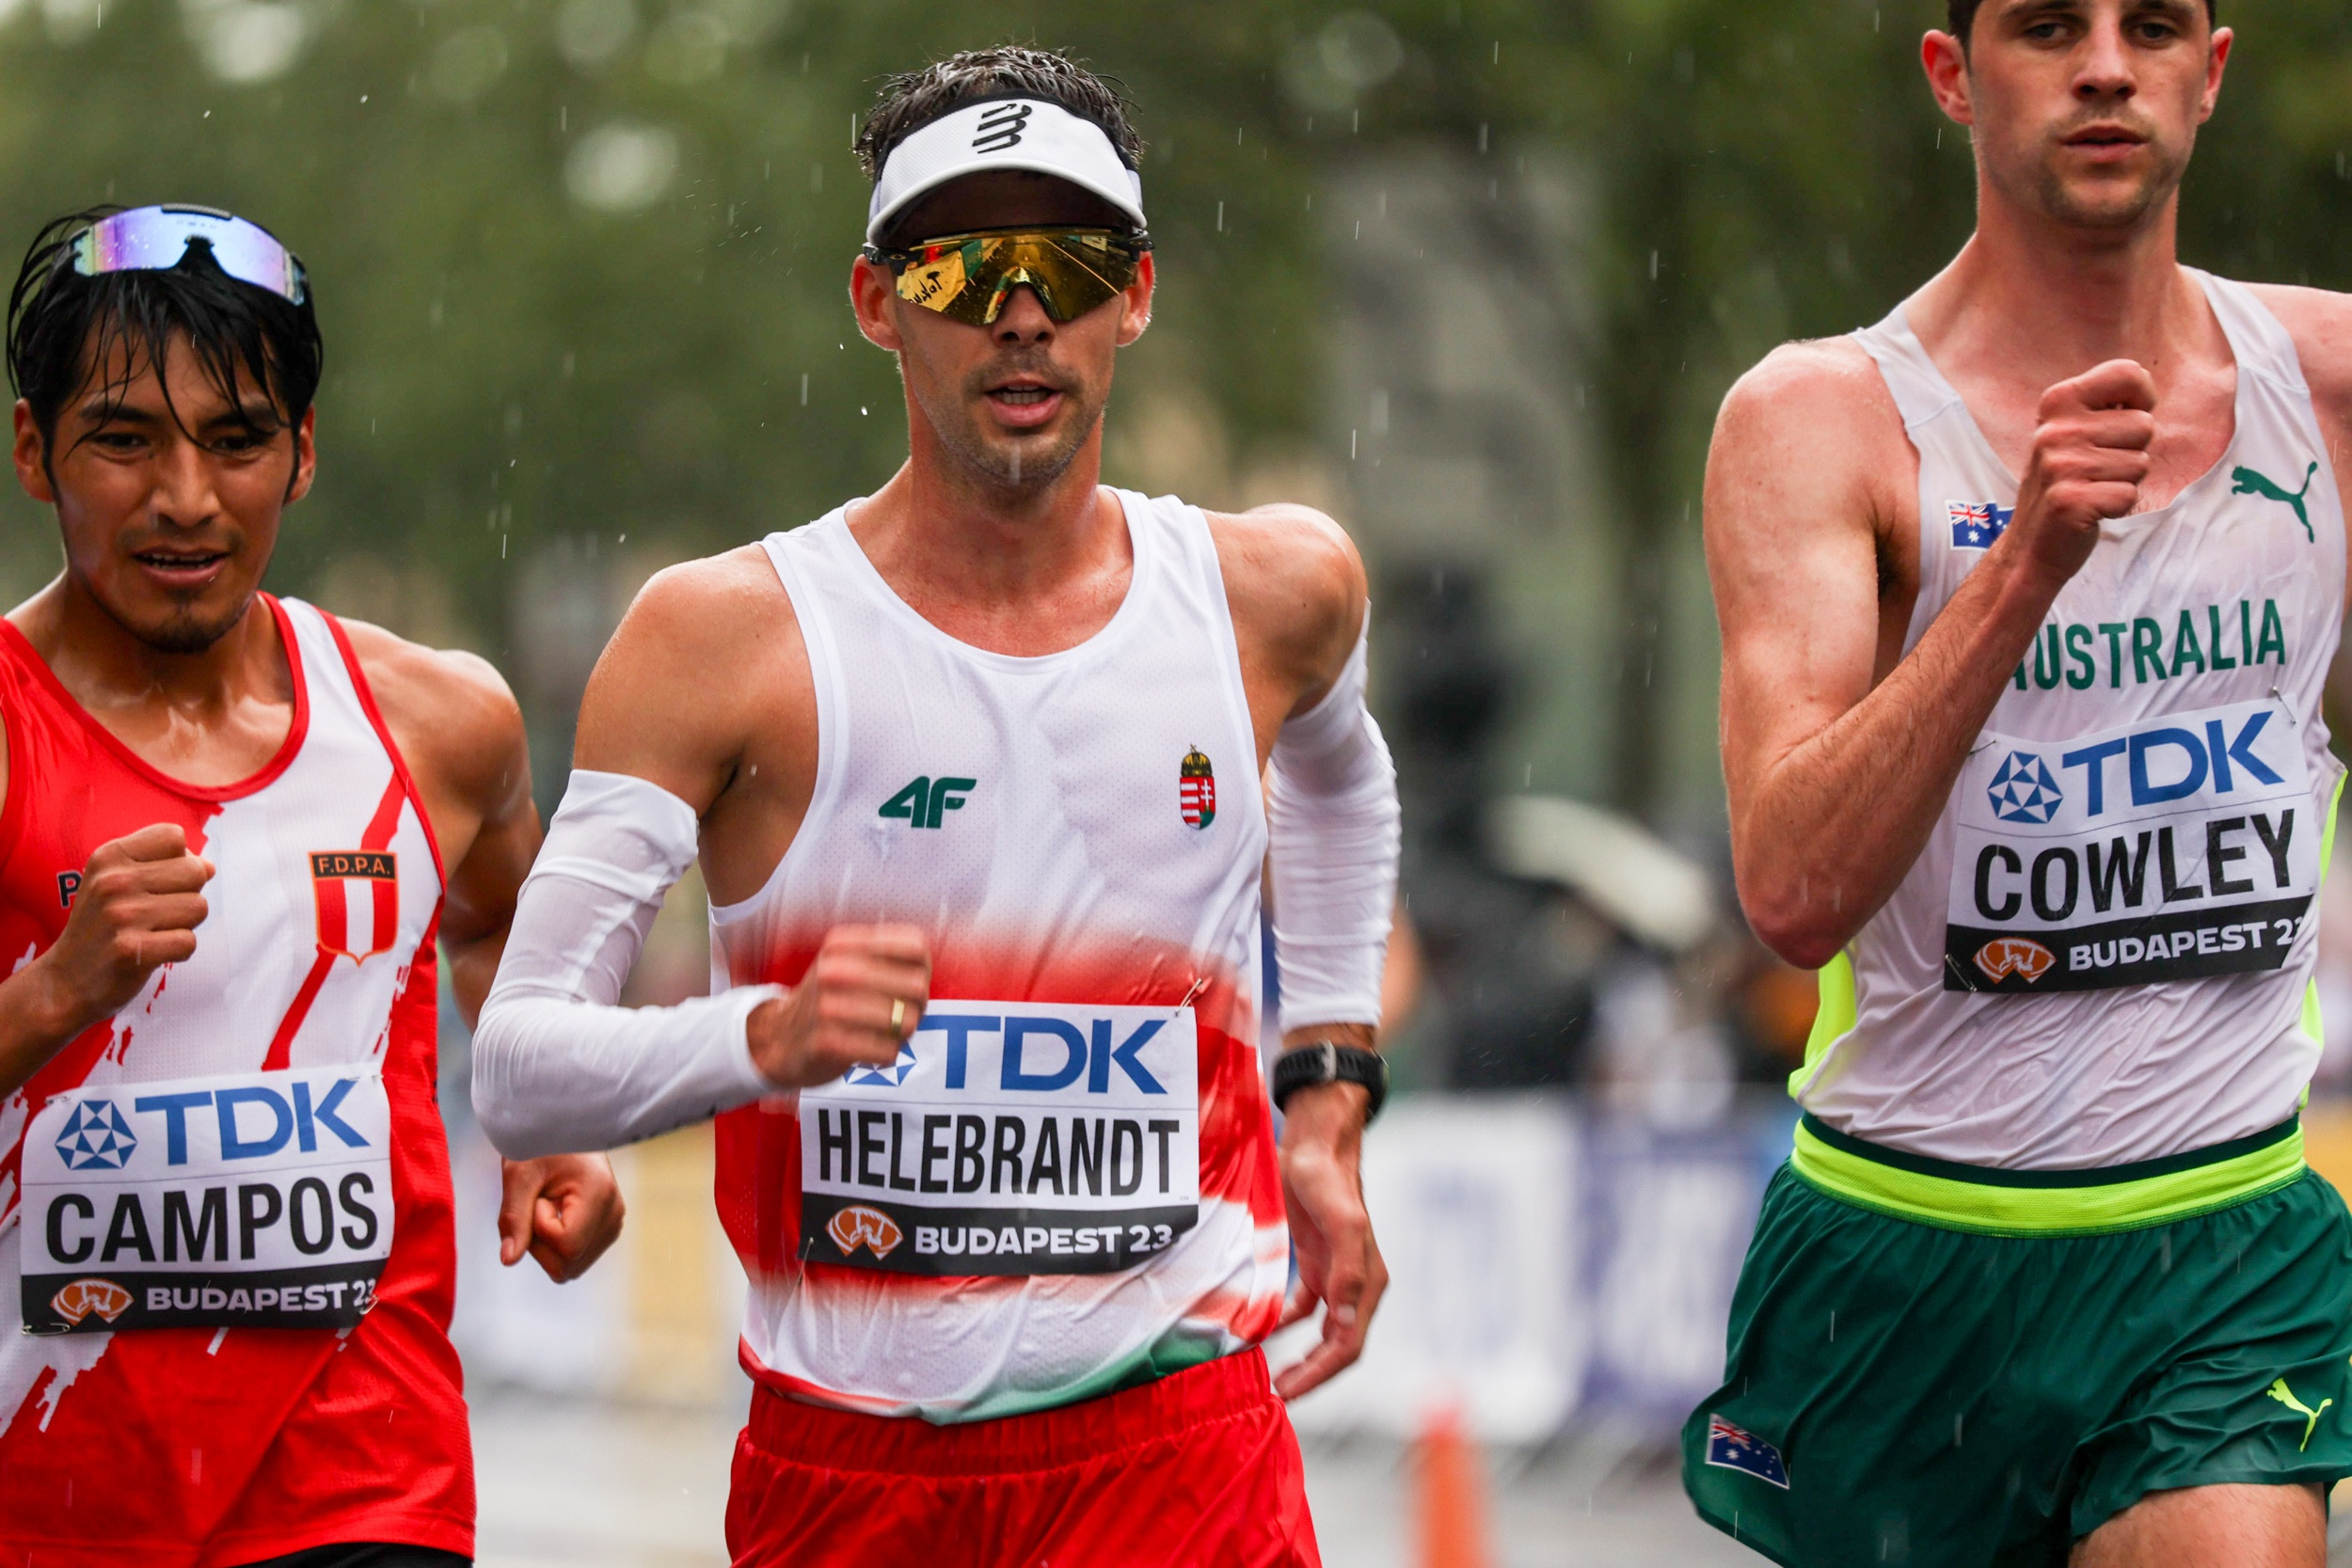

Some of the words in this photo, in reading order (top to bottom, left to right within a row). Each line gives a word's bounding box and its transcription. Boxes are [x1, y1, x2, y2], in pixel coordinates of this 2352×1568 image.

[878, 776, 977, 829] 4F
[2062, 711, 2286, 816] TDK
[318, 857, 390, 875] F.D.P.A.
[1974, 808, 2296, 922] COWLEY
[2069, 921, 2268, 972] BUDAPEST
[2273, 916, 2303, 946] 2
[917, 1014, 1168, 1096] TDK
[135, 1078, 371, 1166] TDK
[817, 1108, 1181, 1196] HELEBRANDT
[45, 1172, 378, 1264] CAMPOS
[914, 1225, 1123, 1255] BUDAPEST
[1129, 1225, 1172, 1253] 23
[147, 1281, 348, 1312] BUDAPEST
